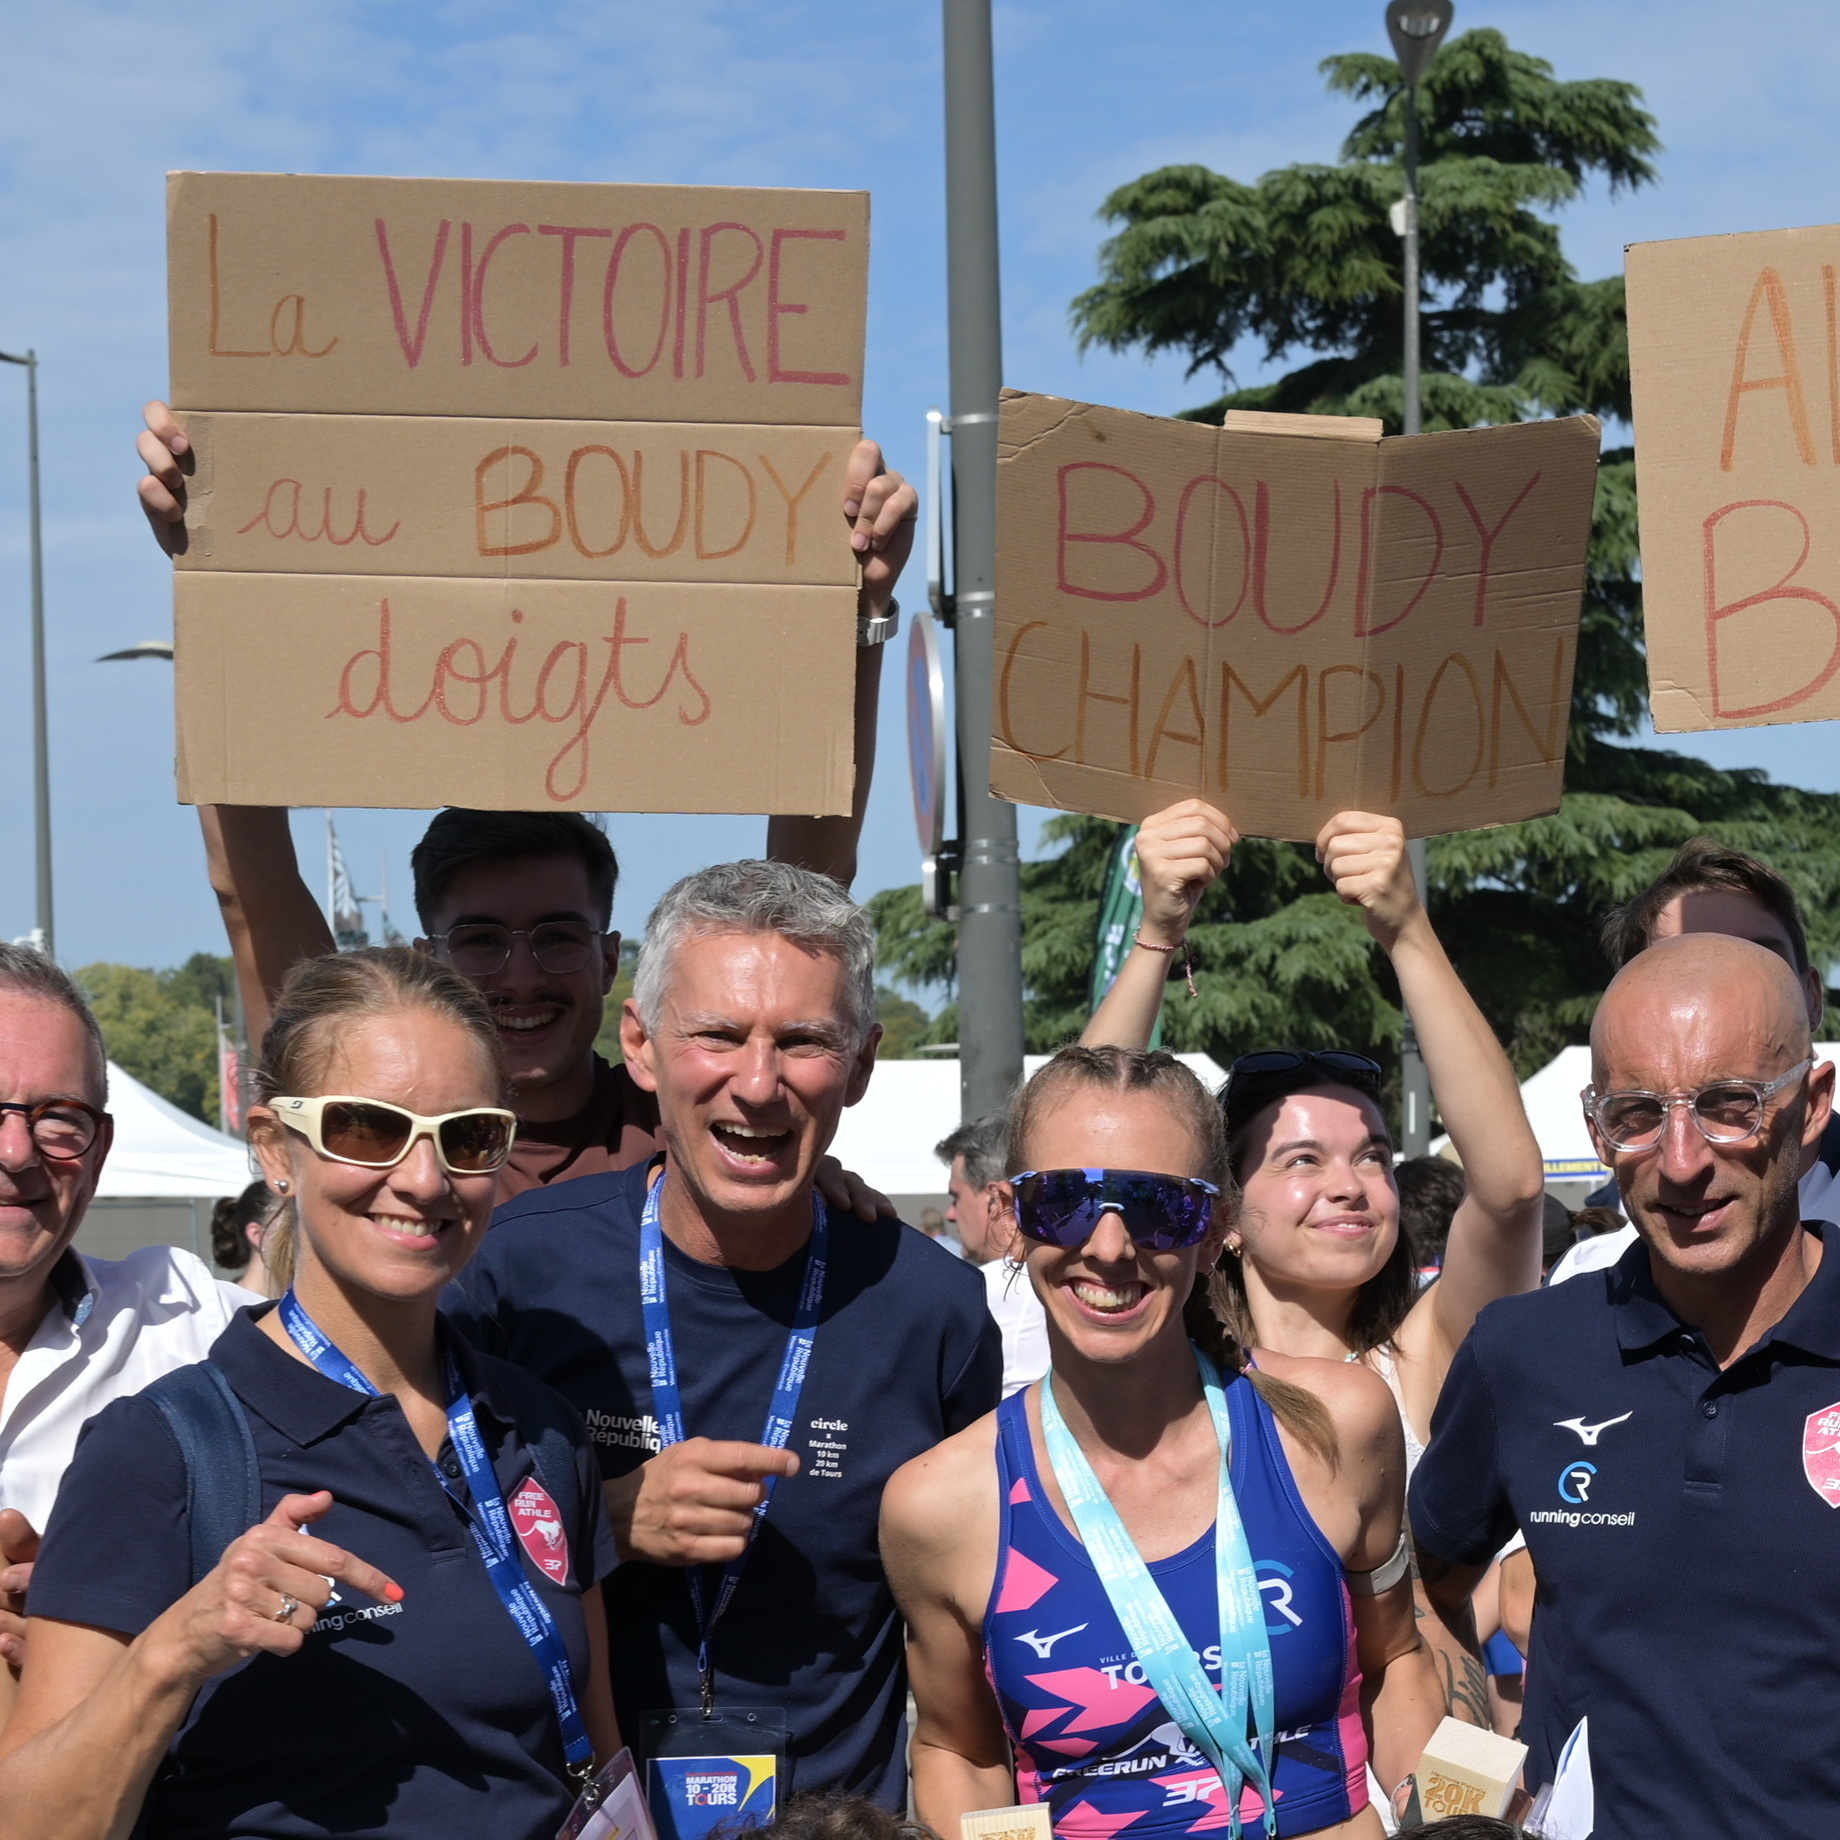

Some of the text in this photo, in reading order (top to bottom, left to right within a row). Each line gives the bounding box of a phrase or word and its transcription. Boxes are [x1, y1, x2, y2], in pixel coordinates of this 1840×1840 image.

[207, 213, 851, 386] La VICTOIRE
[237, 444, 834, 566] au BOUDY
[1055, 461, 1543, 637] BOUDY
[324, 597, 712, 803] doigts
[998, 620, 1565, 802] CHAMPION
[586, 1409, 661, 1434] Nouvelle
[810, 1418, 848, 1431] circle
[587, 1427, 661, 1454] Républiq
[808, 1440, 847, 1450] Marathon
[826, 1460, 838, 1468] km
[827, 1451, 839, 1459] km
[514, 1500, 536, 1508] RUN
[518, 1491, 545, 1500] FREE
[518, 1508, 552, 1518] ATHLE
[1530, 1509, 1635, 1528] runningconseil
[544, 1559, 562, 1570] 37
[1100, 1653, 1126, 1664] VILLE
[1101, 1646, 1221, 1690] TOS
[1052, 1755, 1167, 1778] FREERUN
[686, 1775, 737, 1784] MARATHON
[686, 1785, 700, 1794] 10
[711, 1783, 737, 1793] 20K
[686, 1793, 737, 1806] TOURS
[1162, 1776, 1223, 1807] 37
[1425, 1777, 1486, 1813] 20K
[1424, 1796, 1472, 1815] TOU
